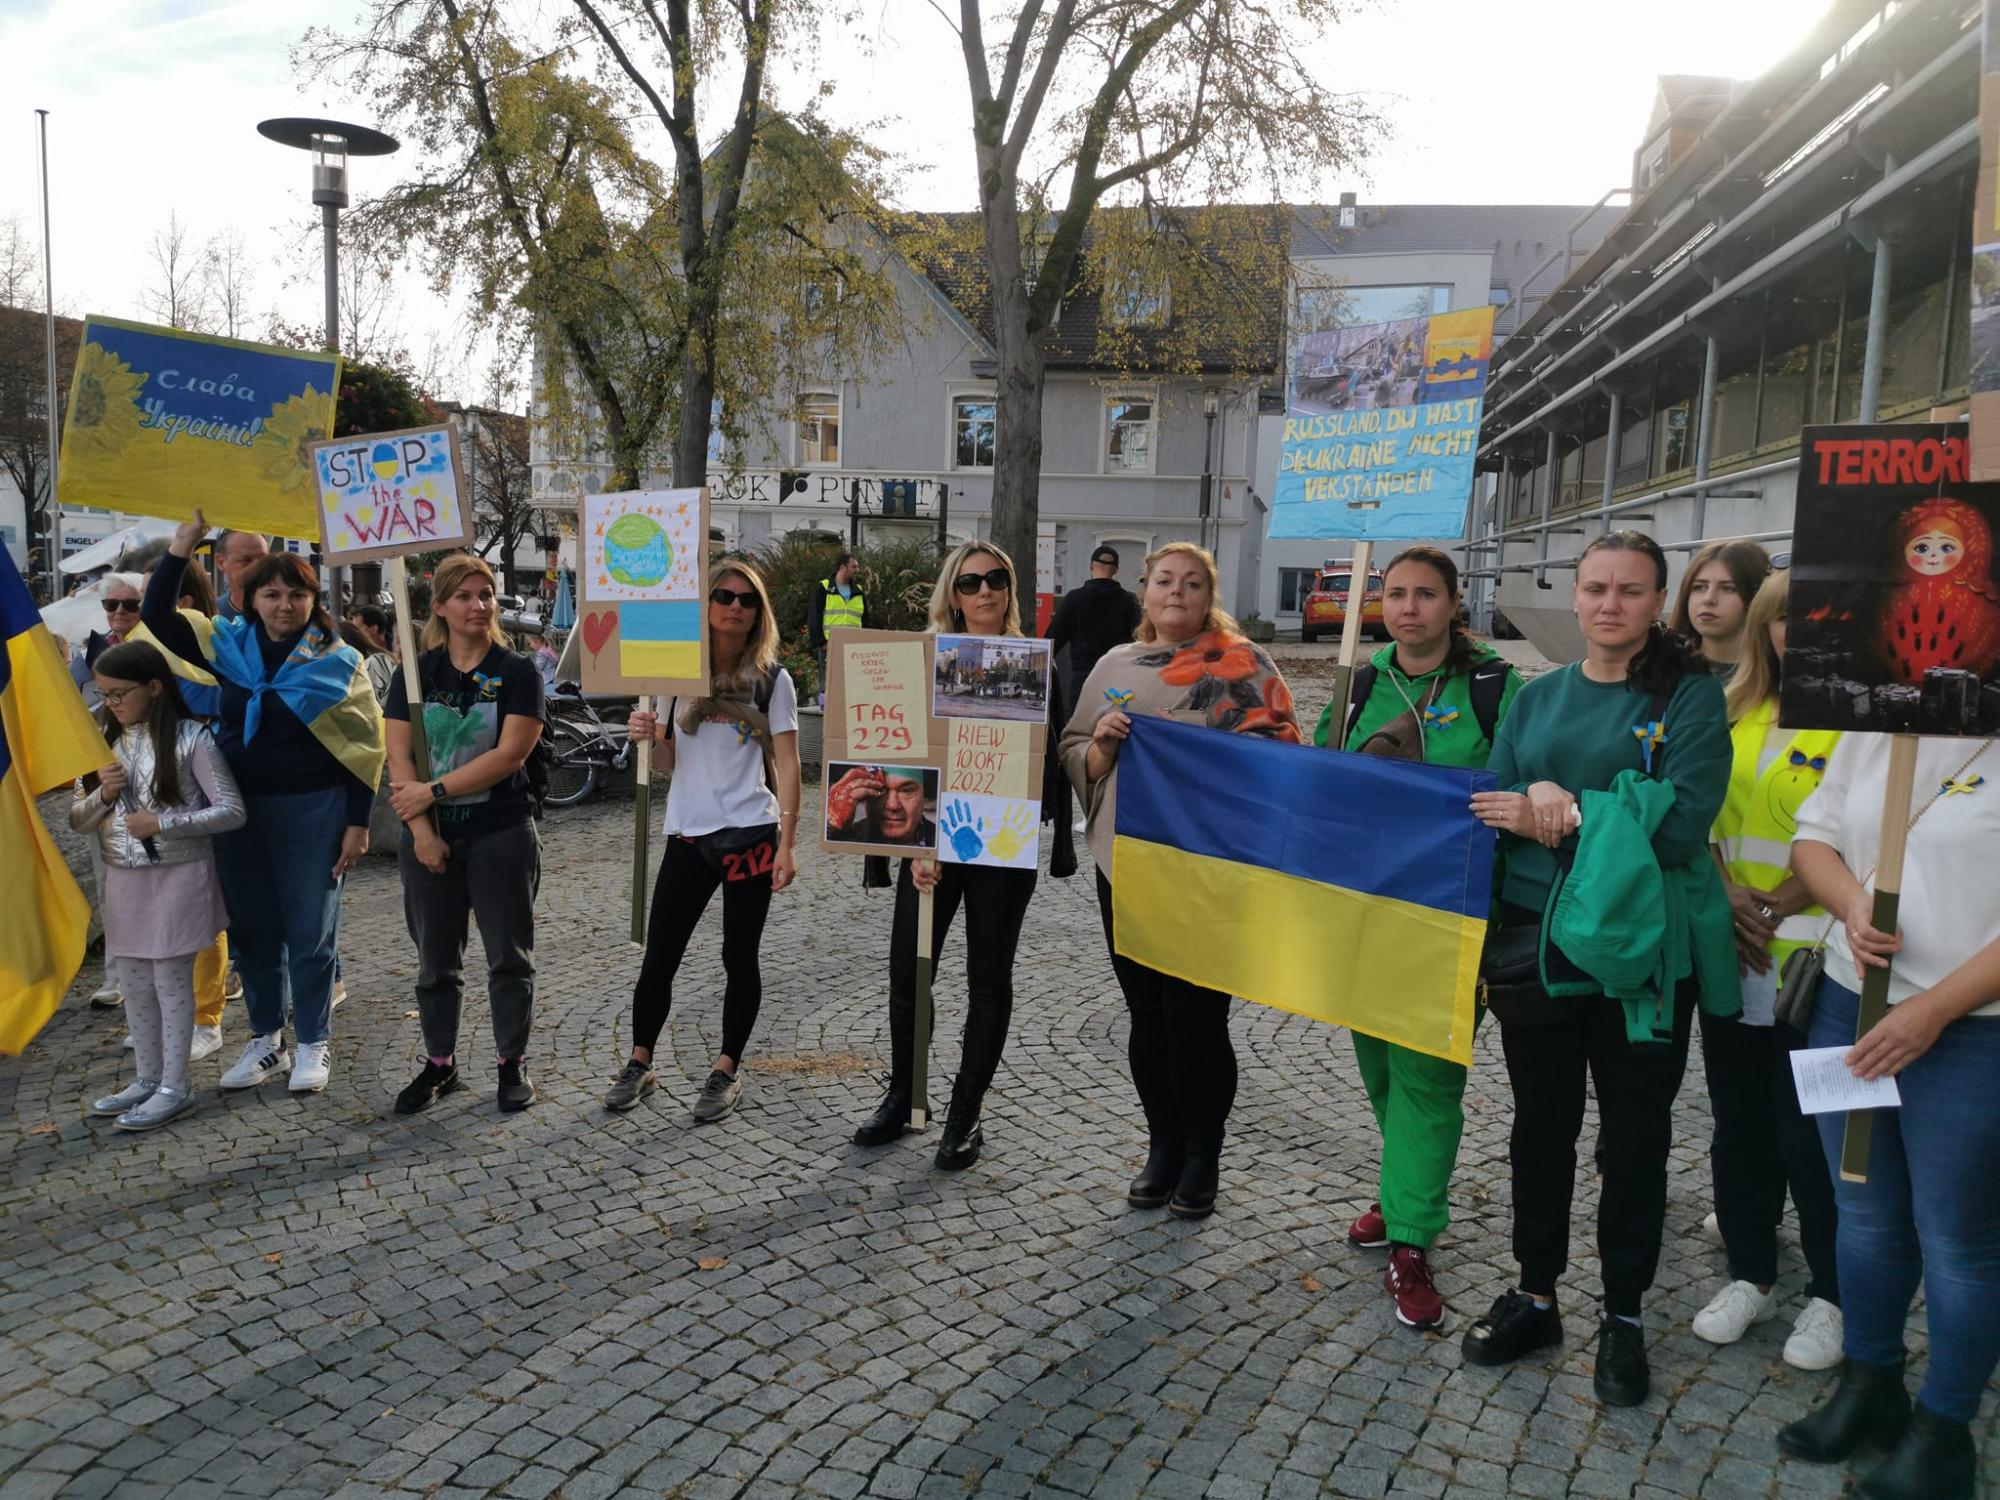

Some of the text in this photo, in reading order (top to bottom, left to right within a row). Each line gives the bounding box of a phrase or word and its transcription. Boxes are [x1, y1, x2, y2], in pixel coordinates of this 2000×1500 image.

[157, 368, 256, 402] Слава
[139, 396, 264, 447] Україні!
[1387, 408, 1418, 433] DU
[1426, 398, 1479, 427] HAST
[330, 439, 426, 488] STOP
[1307, 438, 1398, 472] UKRAINE
[1406, 429, 1477, 459] NICHT
[371, 484, 403, 506] the
[1304, 467, 1434, 502] VERSTANDEN
[344, 498, 437, 543] WAR
[850, 703, 904, 722] TAG
[853, 727, 912, 750] 229
[957, 722, 1006, 748] KIEW
[975, 751, 1009, 772] OKT
[950, 769, 996, 796] 2022
[722, 841, 774, 881] 212
